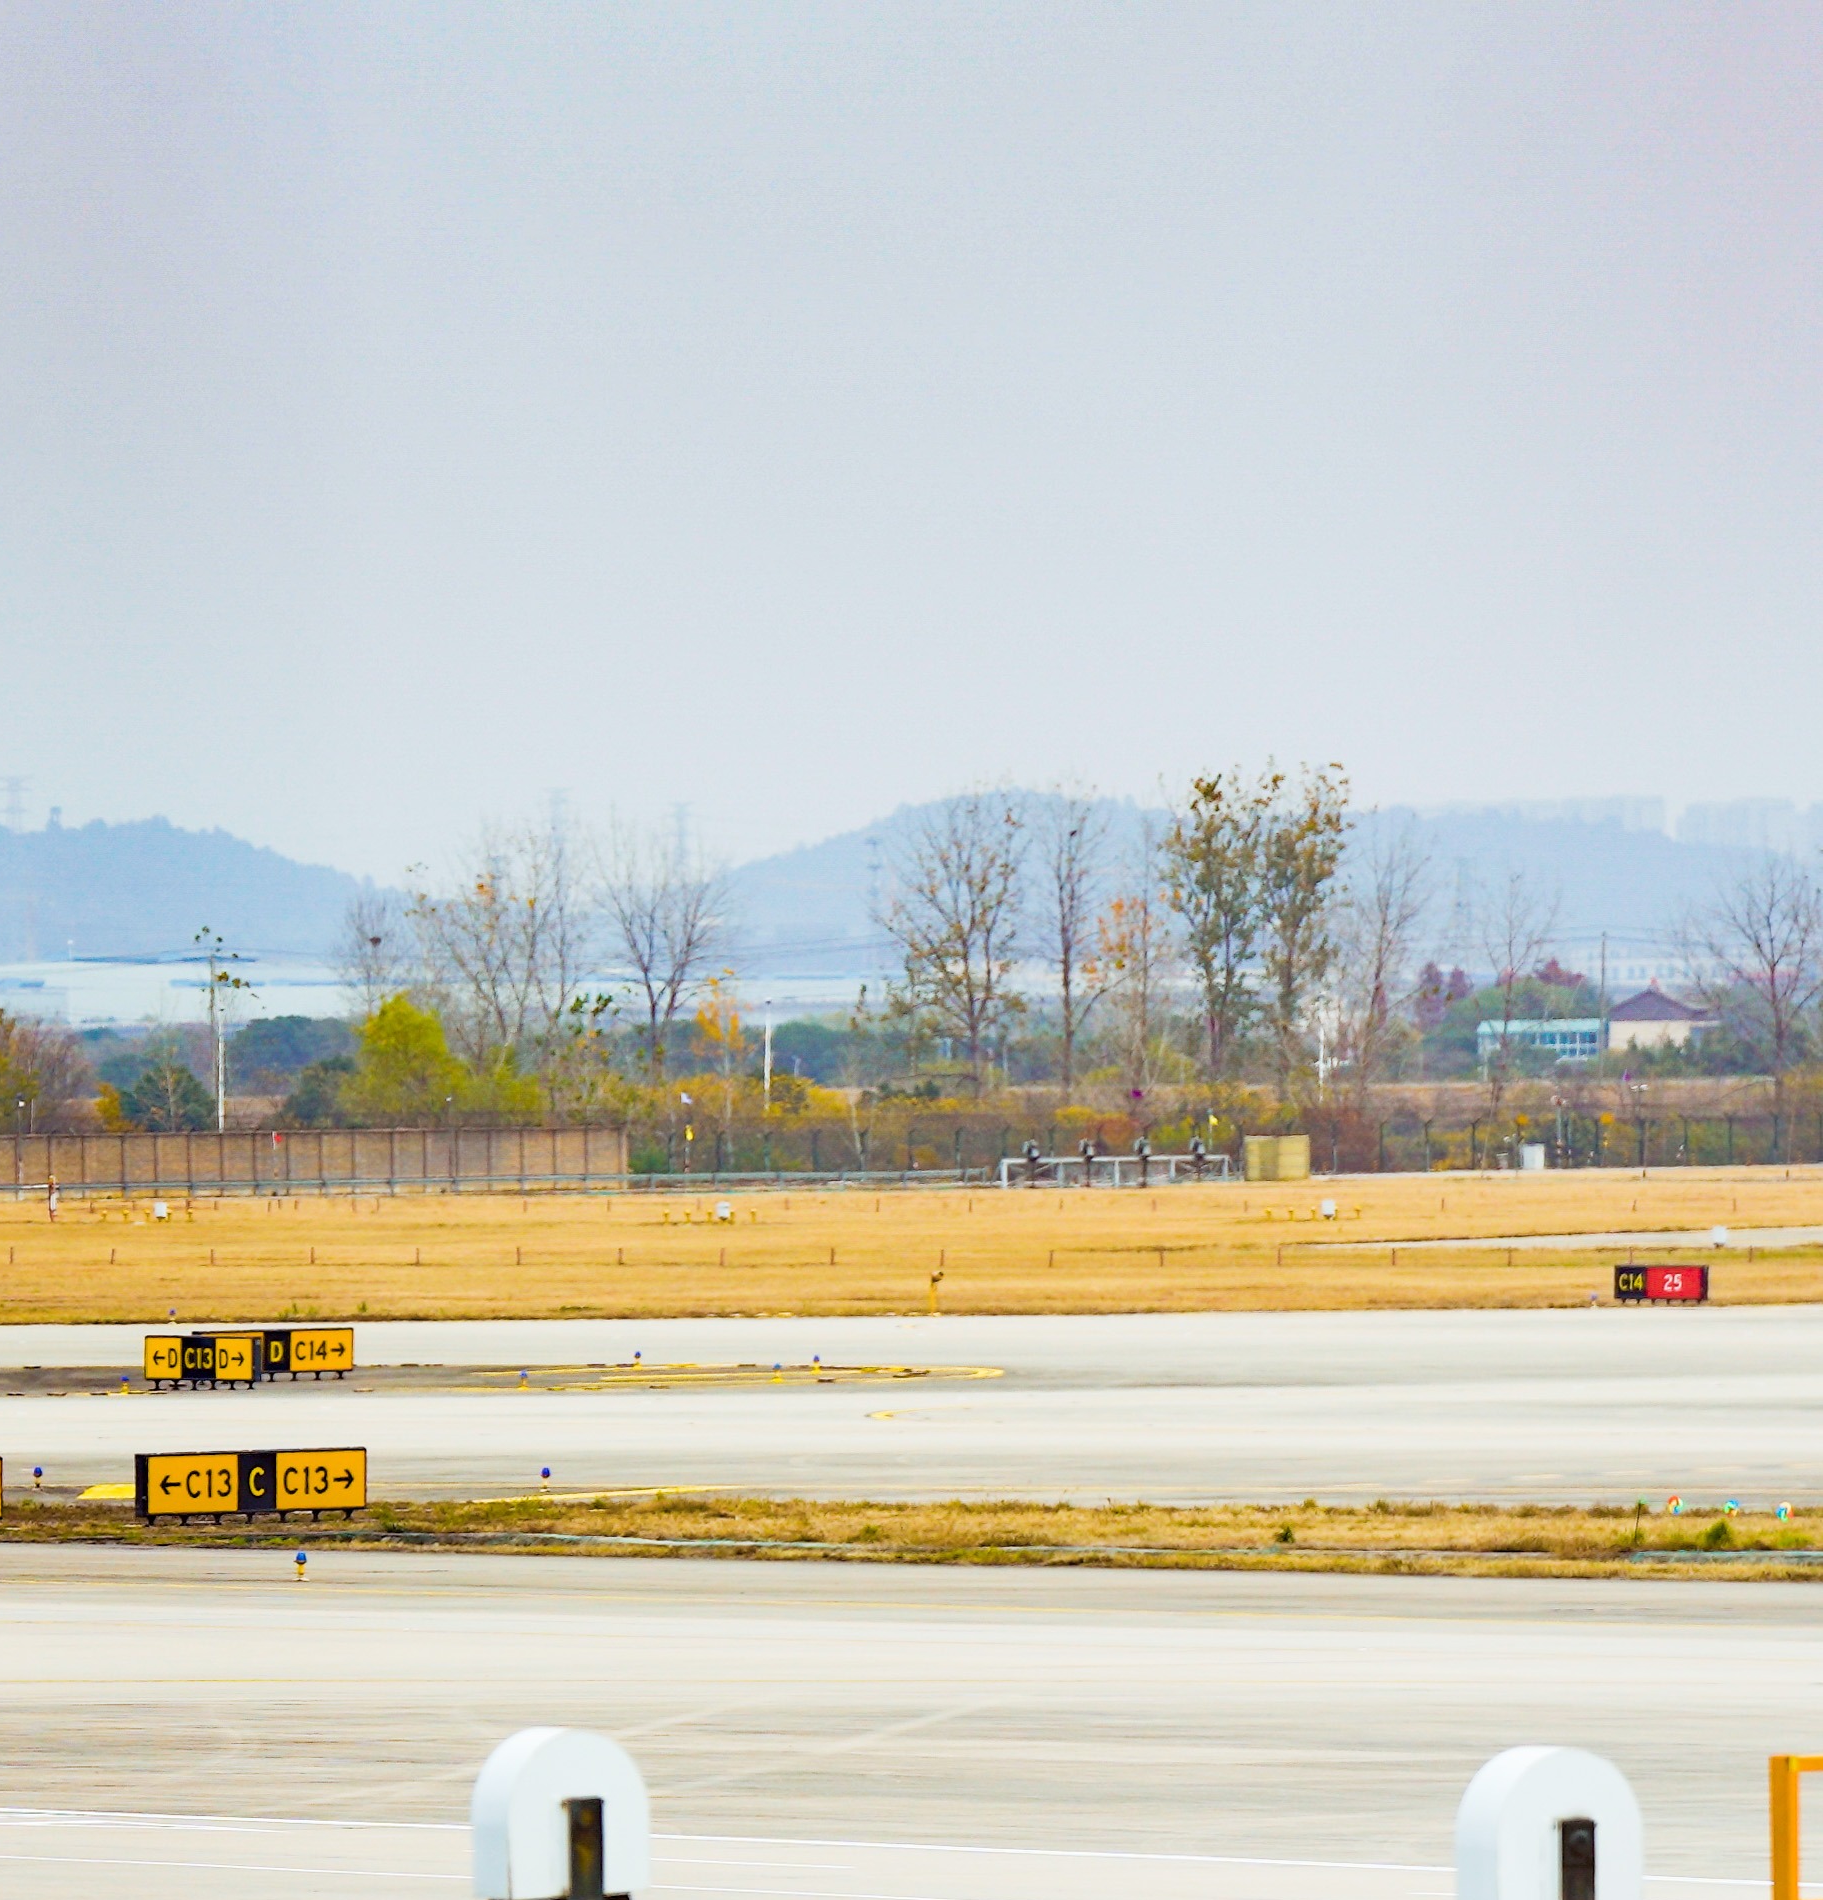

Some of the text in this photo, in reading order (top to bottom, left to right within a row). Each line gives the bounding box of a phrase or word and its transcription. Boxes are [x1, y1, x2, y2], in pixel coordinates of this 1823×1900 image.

[1618, 1272, 1683, 1292] C14 25
[167, 1347, 229, 1370] D C13 D
[269, 1340, 328, 1363] D C14
[186, 1465, 329, 1499] C13 C C13
